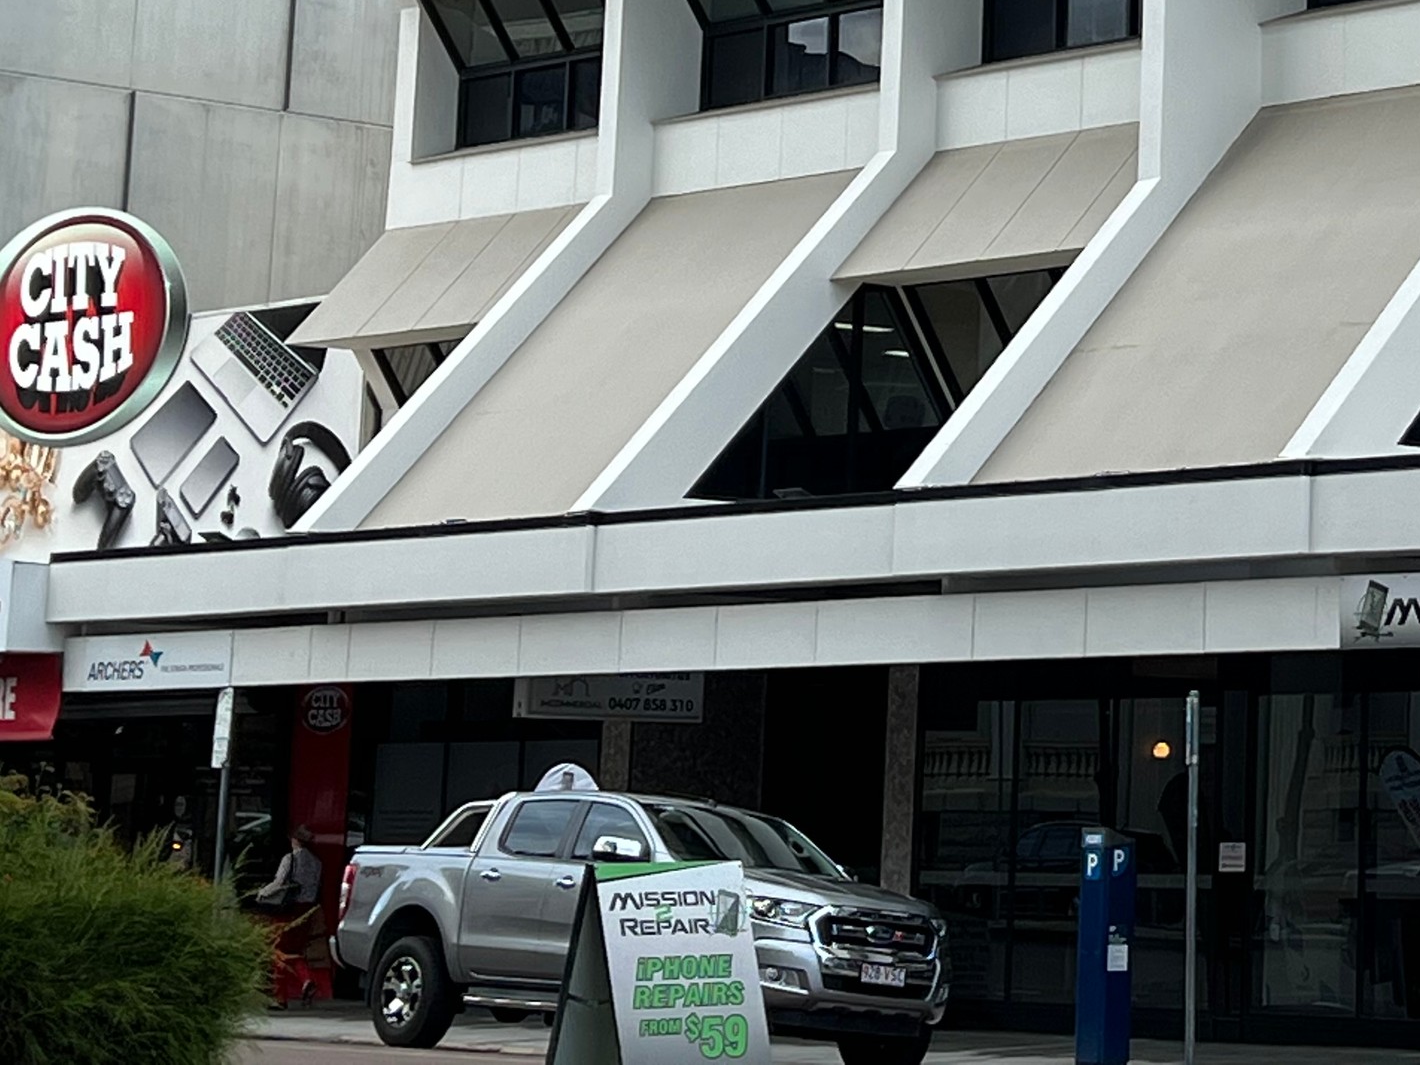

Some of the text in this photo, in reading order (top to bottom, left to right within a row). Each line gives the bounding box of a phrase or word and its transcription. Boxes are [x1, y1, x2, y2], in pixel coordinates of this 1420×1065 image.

[20, 242, 126, 318] CITY
[8, 310, 135, 393] CASH
[87, 660, 145, 681] ARCHERS
[311, 691, 340, 708] CITY
[608, 697, 640, 711] 0407
[643, 698, 667, 712] 858
[669, 699, 694, 712] 310
[307, 708, 342, 727] CASH
[1086, 853, 1099, 876] P
[1113, 848, 1125, 872] P
[609, 890, 716, 911] MISSION
[655, 904, 673, 922] 2
[619, 918, 712, 936] REPAIR
[636, 954, 733, 981] iPHONE
[633, 980, 745, 1010] REPAIRS
[638, 1012, 749, 1060] FROM $59
